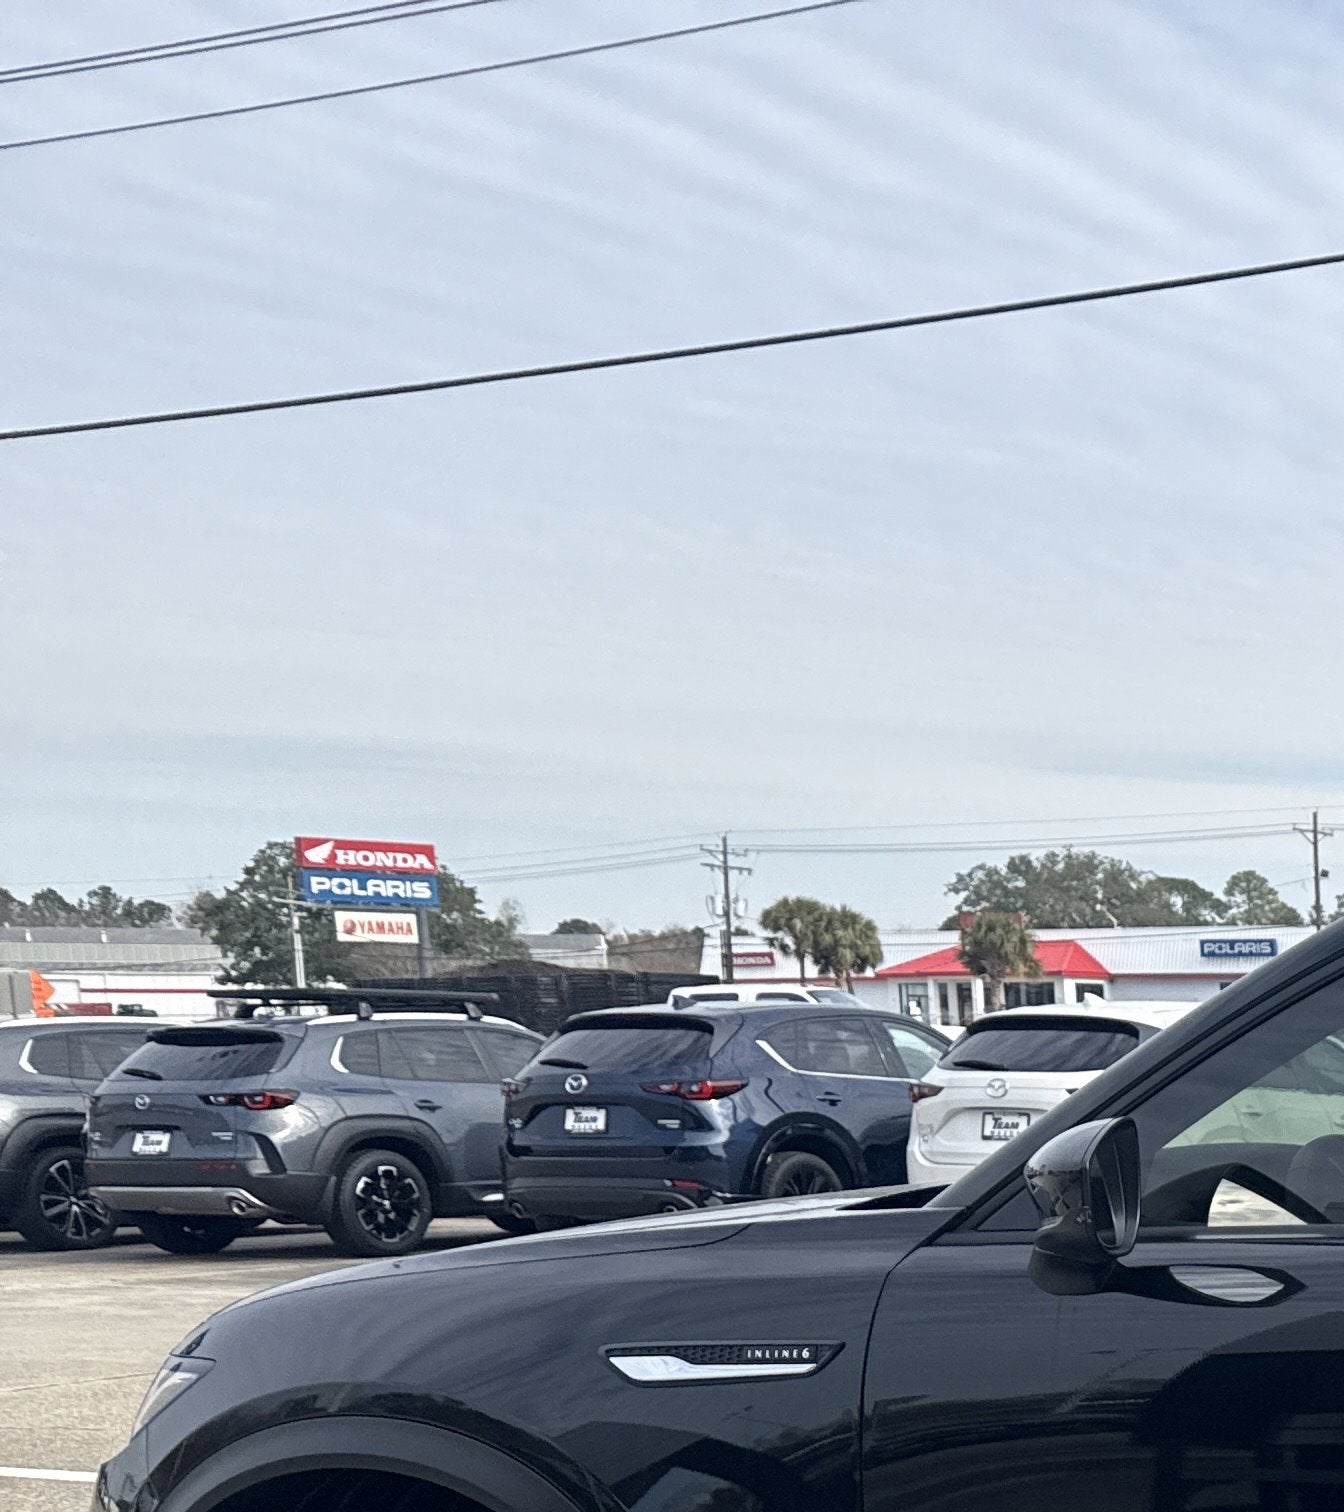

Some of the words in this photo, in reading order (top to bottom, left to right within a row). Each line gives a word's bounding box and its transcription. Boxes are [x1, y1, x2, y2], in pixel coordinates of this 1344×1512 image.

[334, 849, 434, 869] HONDA
[310, 876, 432, 898] POLARIS
[358, 920, 413, 935] YAMAHA
[1203, 942, 1272, 954] POLARIS
